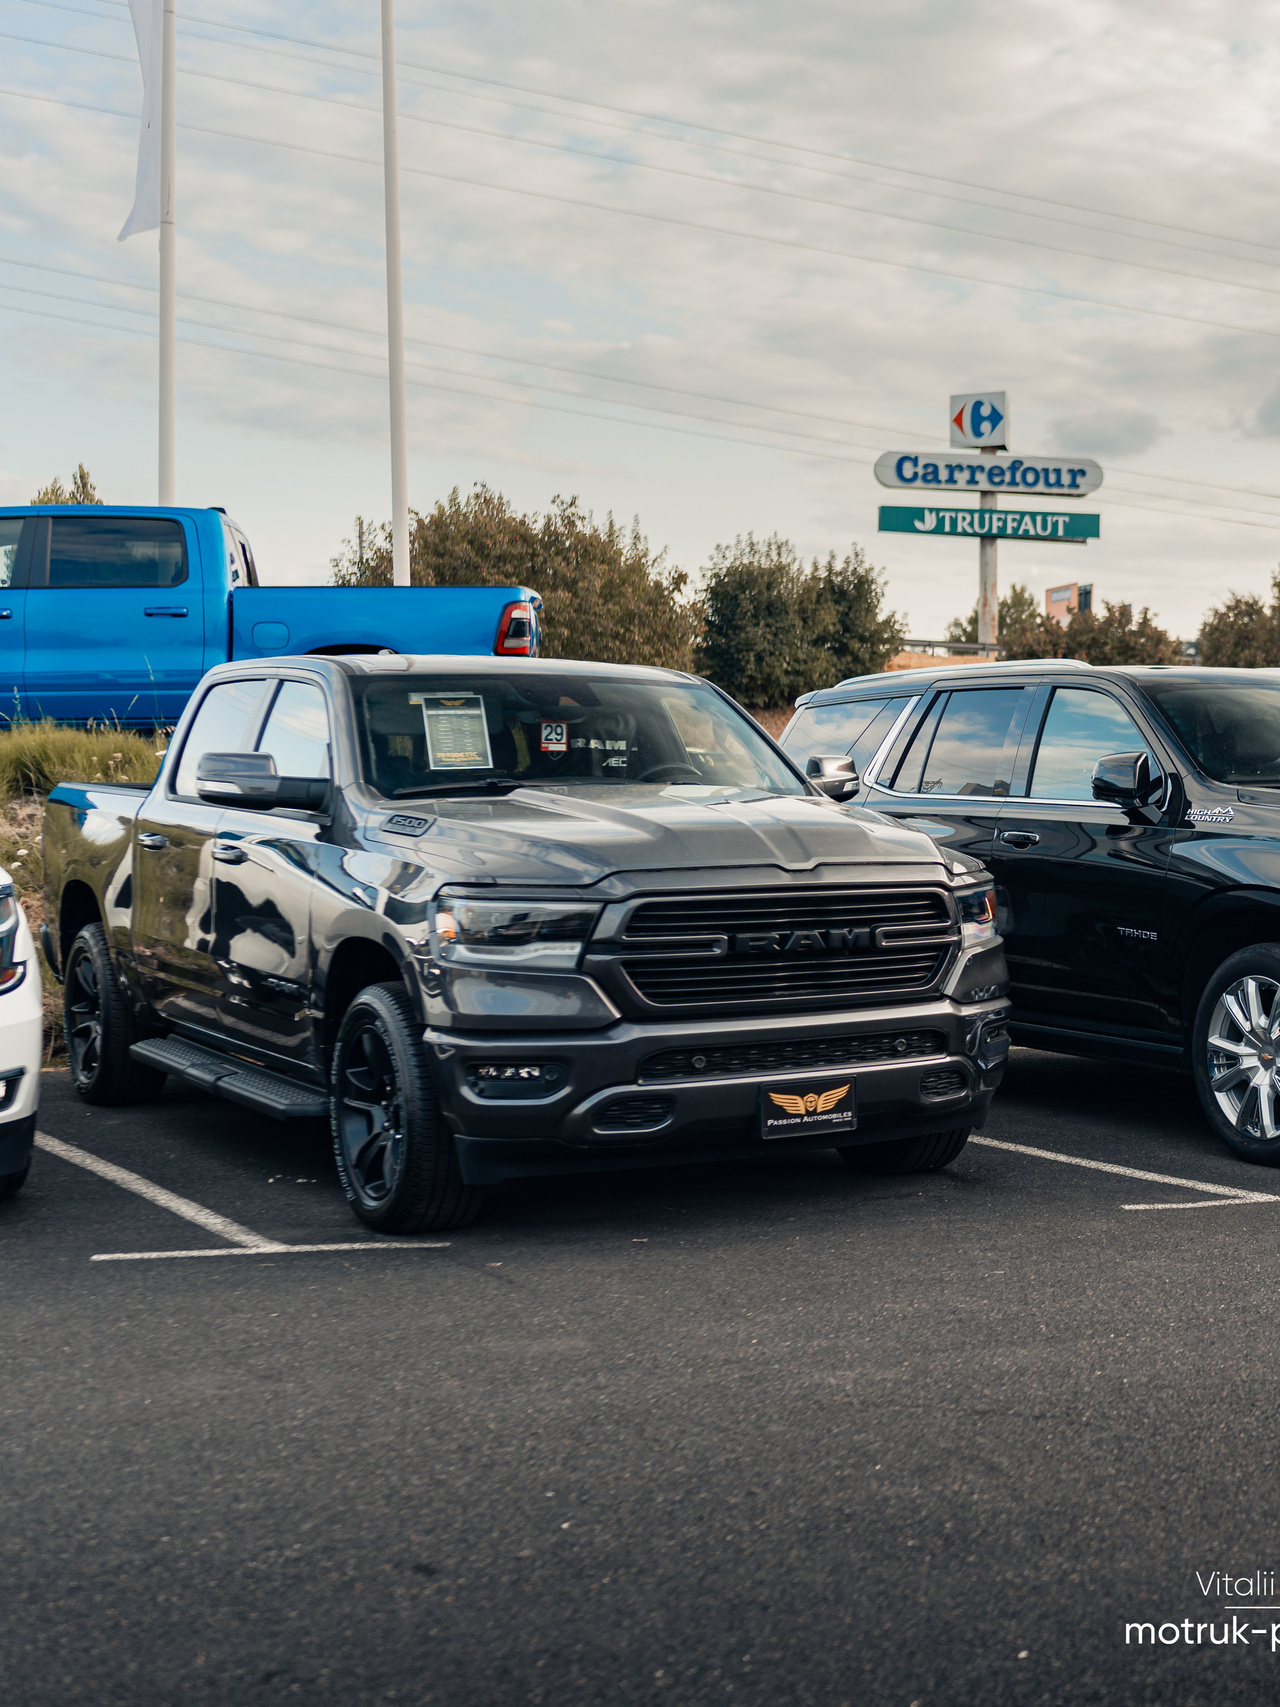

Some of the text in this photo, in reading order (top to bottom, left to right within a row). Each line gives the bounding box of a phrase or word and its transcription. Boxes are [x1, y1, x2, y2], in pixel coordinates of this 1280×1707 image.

[895, 455, 1086, 489] Carrefour
[939, 511, 1069, 537] TRUFFAUT
[543, 723, 564, 742] 29
[570, 738, 627, 750] RAM
[391, 816, 425, 828] 1500
[1184, 815, 1233, 823] COUNTRY
[735, 929, 871, 952] RAM
[1116, 926, 1158, 940] TAHOE
[767, 1117, 801, 1126] PASSION
[802, 1111, 853, 1123] AUTOMOBILES
